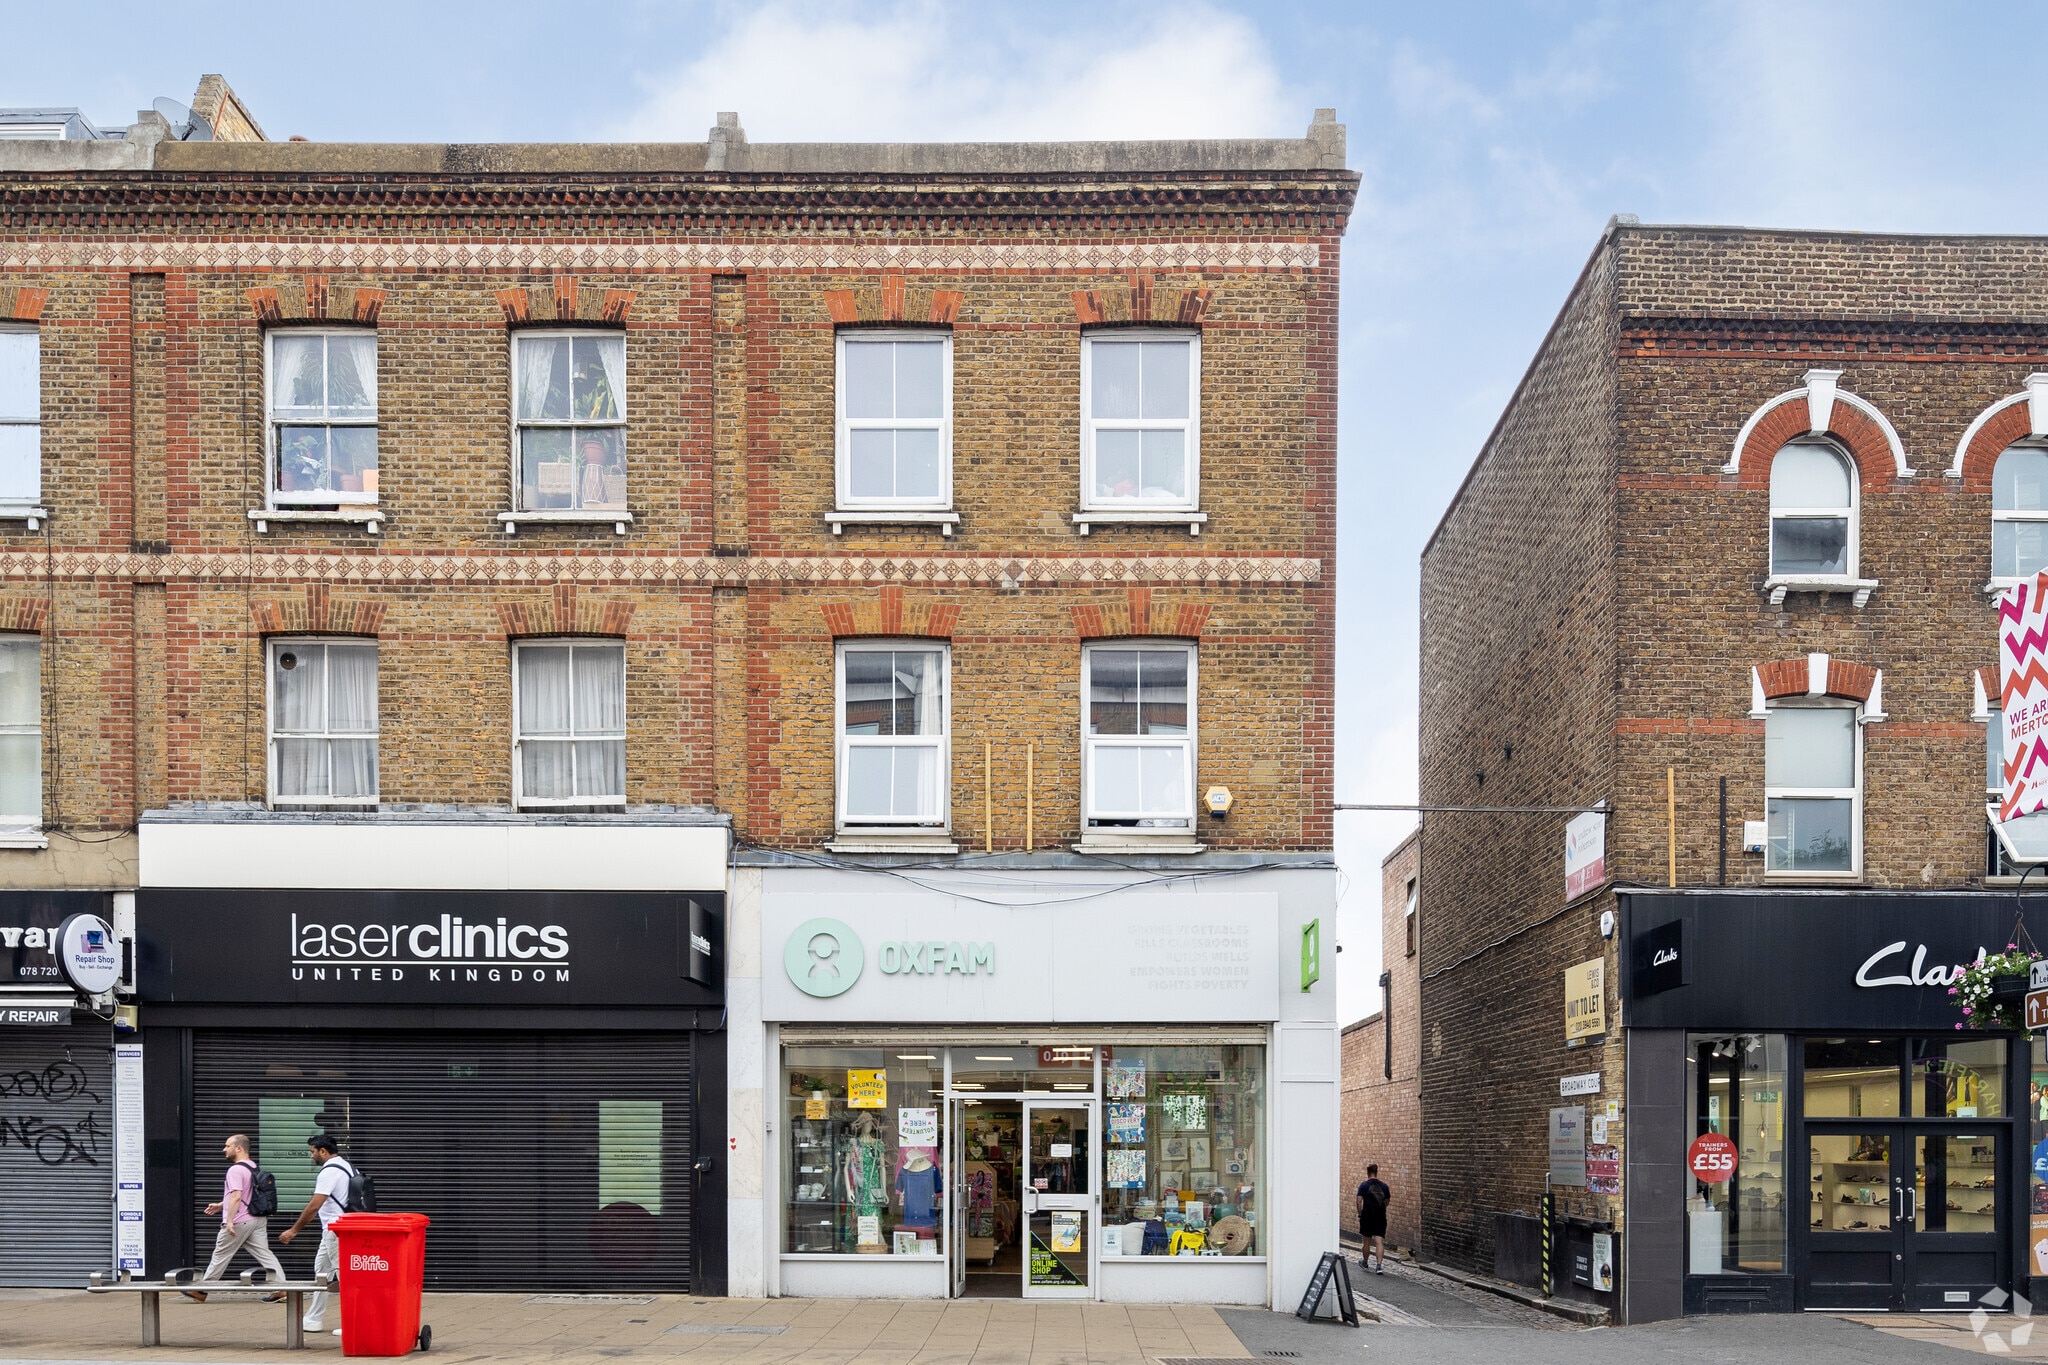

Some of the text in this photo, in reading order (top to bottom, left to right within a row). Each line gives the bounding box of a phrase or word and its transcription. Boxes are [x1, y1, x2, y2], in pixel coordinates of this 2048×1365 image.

[2010, 699, 2048, 725] WE AR
[1212, 794, 1225, 802] ADT
[292, 913, 568, 958] laserclinics
[75, 954, 115, 964] Repair Shop
[880, 941, 994, 975] OXFAM
[1211, 952, 1249, 961] WELLS
[1653, 947, 1678, 967] Clarks
[20, 967, 58, 976] 078 720
[292, 968, 569, 982] UNITED KINGDOM
[1130, 967, 1249, 976] EMPOWERS WOMEN
[1587, 968, 1599, 980] LEWIS
[1148, 980, 1249, 990] FIGHTS POVERTY
[1567, 994, 1600, 1018] UNIT TO LET
[8, 1010, 59, 1022] REPAIR
[851, 1081, 884, 1090] VOLUNTEER
[1562, 1080, 1586, 1092] BROADWAY
[1110, 1117, 1140, 1125] DISCOVERY
[902, 1126, 935, 1135] VOLUNTEER
[1694, 1154, 1733, 1170] £55
[350, 1255, 389, 1271] Biffa
[1032, 1260, 1057, 1268] ONLINE
